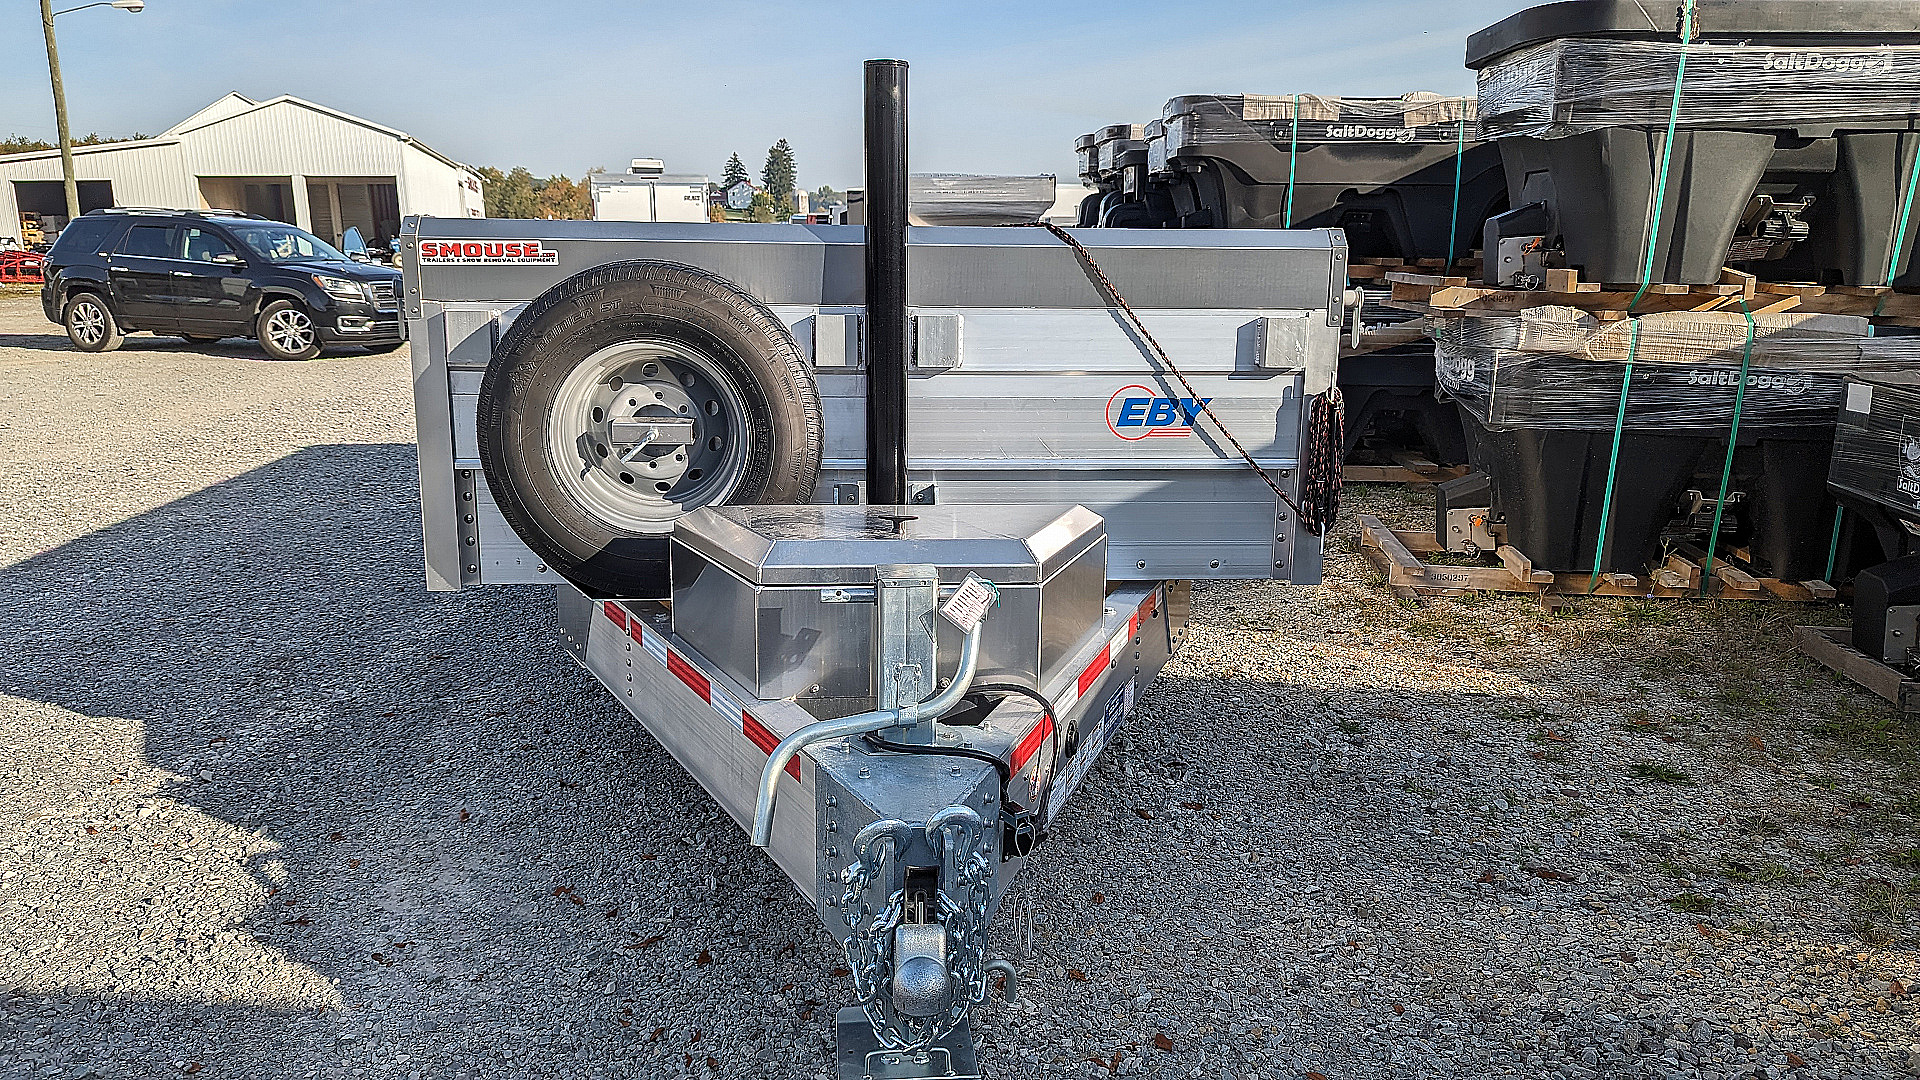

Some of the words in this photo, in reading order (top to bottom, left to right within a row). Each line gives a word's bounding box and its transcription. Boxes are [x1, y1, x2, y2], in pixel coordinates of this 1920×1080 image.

[1763, 53, 1864, 72] SaltDogg
[1326, 125, 1395, 139] SaltDogg
[1688, 371, 1786, 389] SaltDogg
[1116, 398, 1213, 427] EBY
[1431, 573, 1469, 581] 3050297
